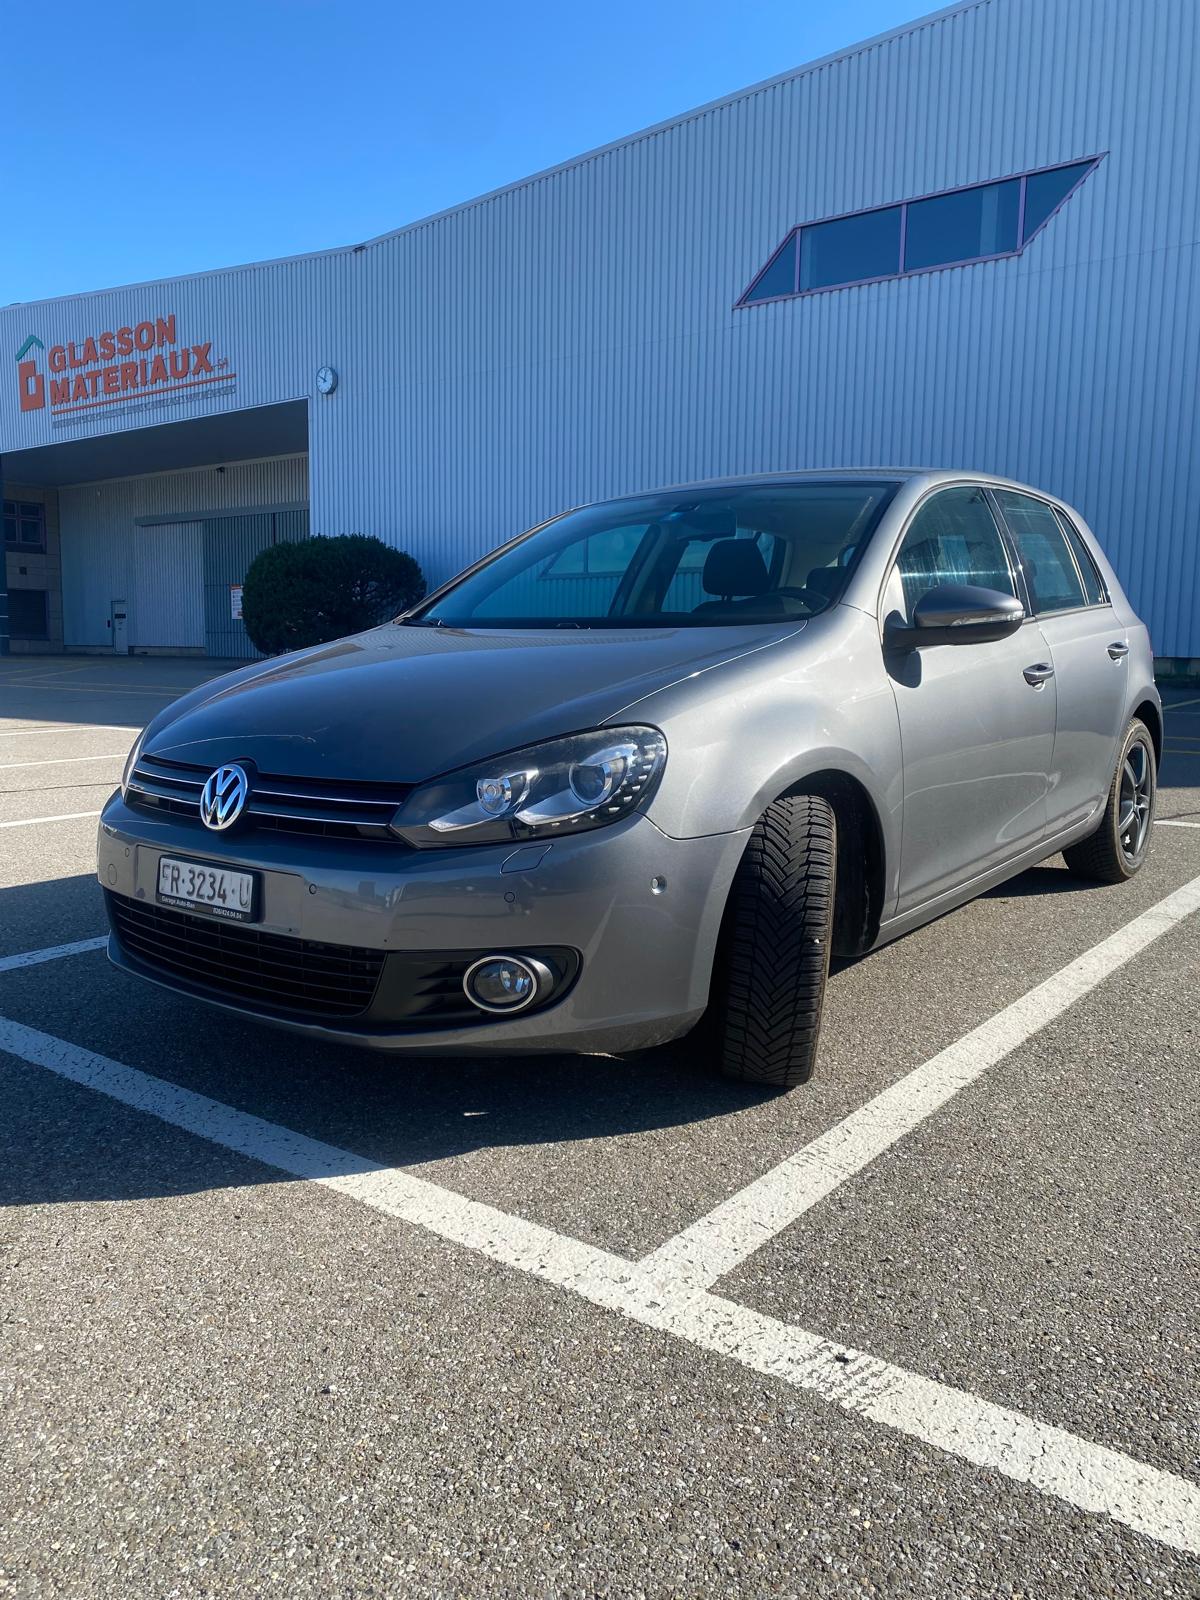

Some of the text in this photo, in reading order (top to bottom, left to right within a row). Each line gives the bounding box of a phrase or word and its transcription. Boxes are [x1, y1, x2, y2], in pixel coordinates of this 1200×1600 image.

[49, 314, 176, 373] GLASSON
[51, 342, 213, 405] MATERIAUX
[201, 764, 248, 830] VW
